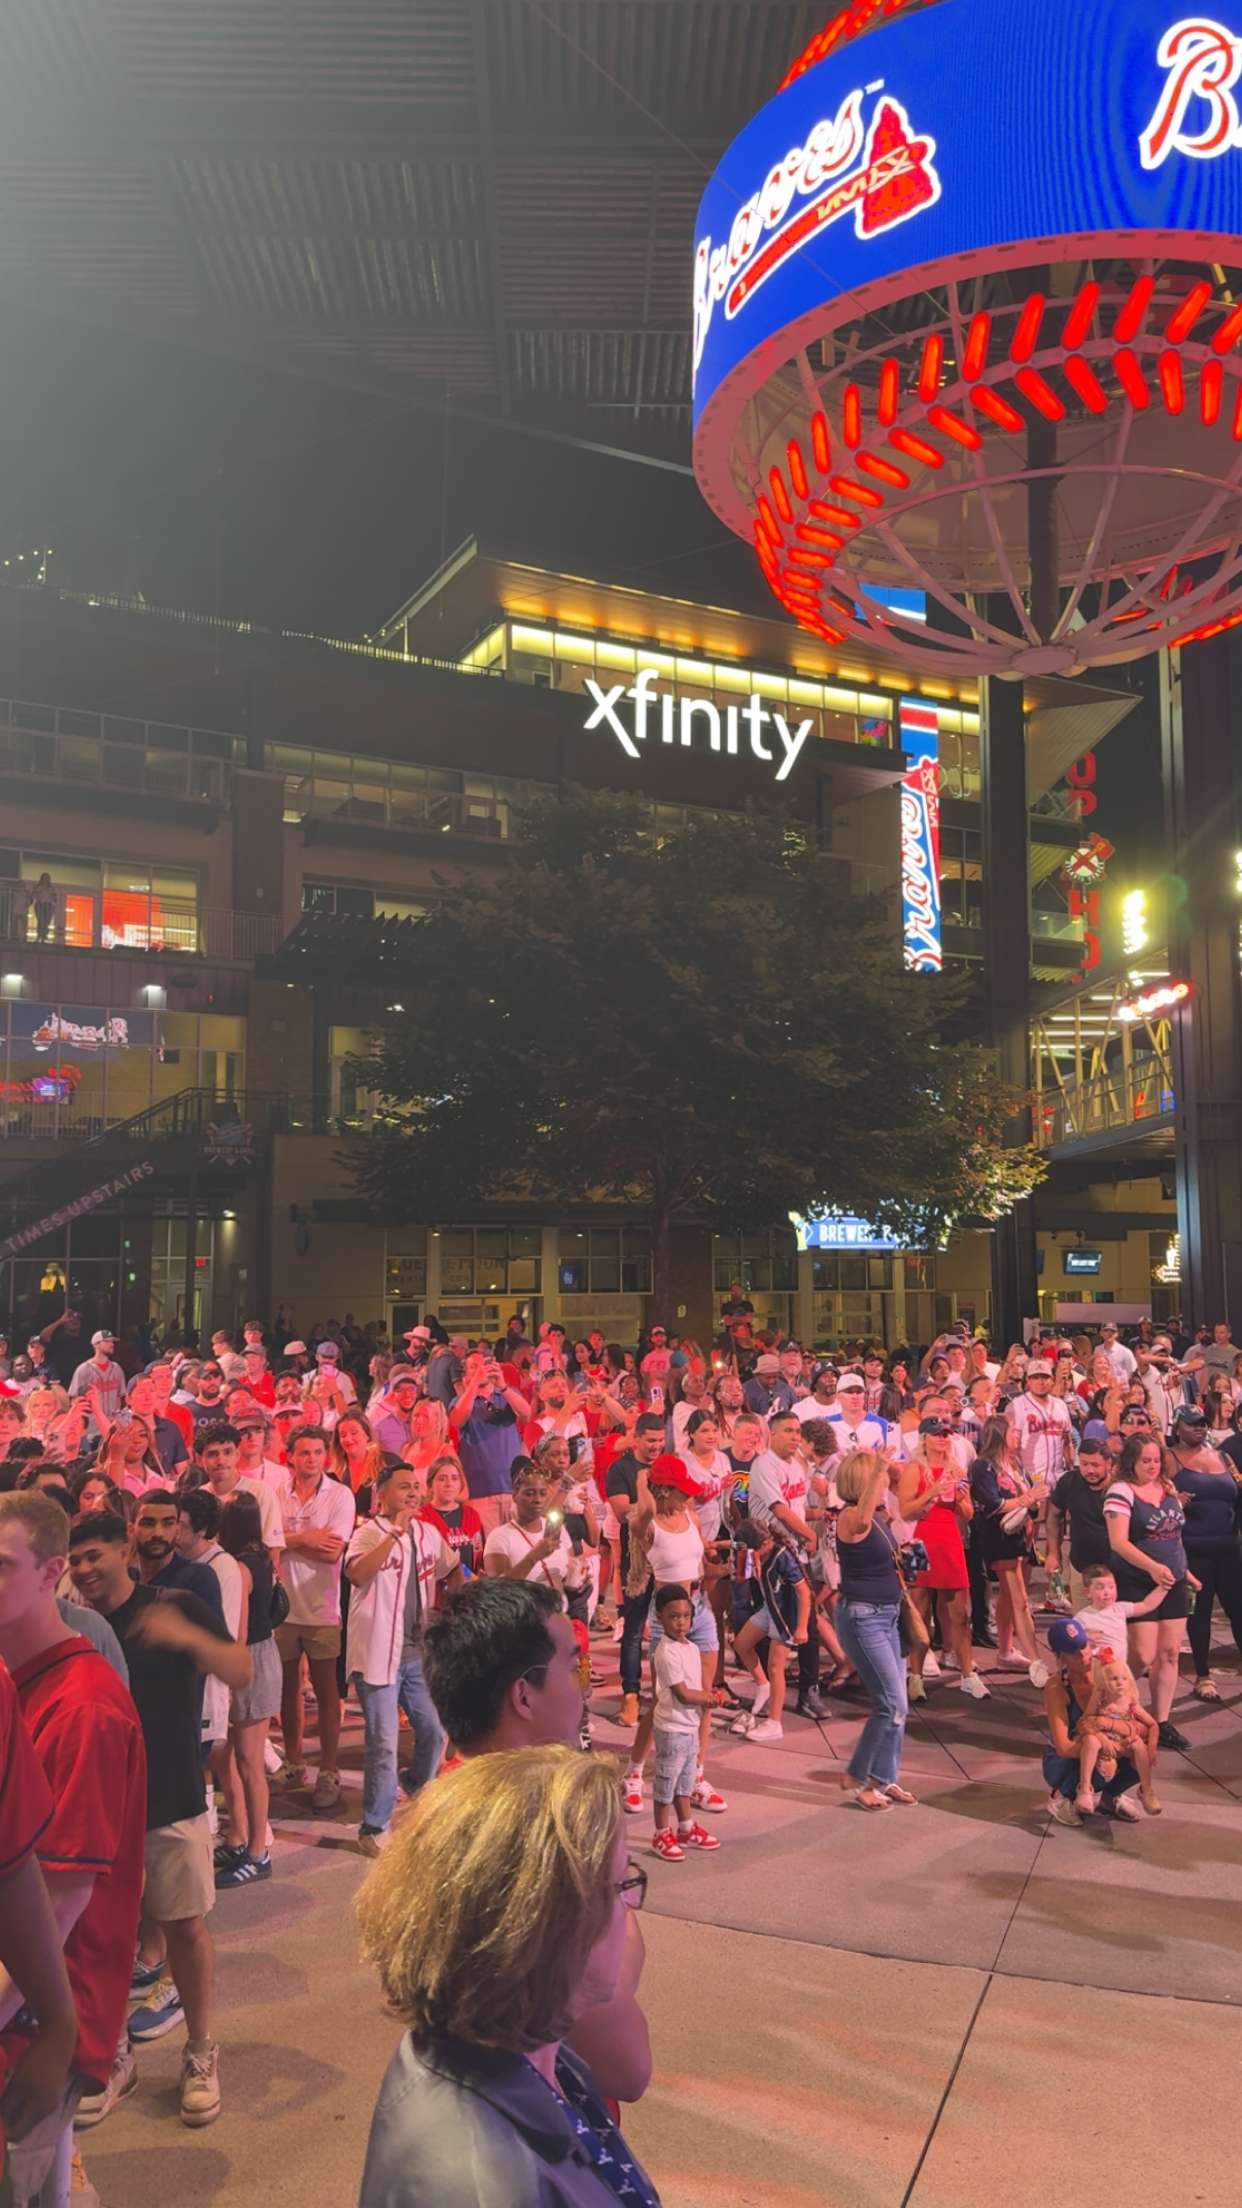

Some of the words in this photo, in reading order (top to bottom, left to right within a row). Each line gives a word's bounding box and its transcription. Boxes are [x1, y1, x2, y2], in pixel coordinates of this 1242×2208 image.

[583, 668, 814, 781] xfinity
[4, 1211, 64, 1251] TIMES
[66, 1160, 155, 1217] UPSTAIRS
